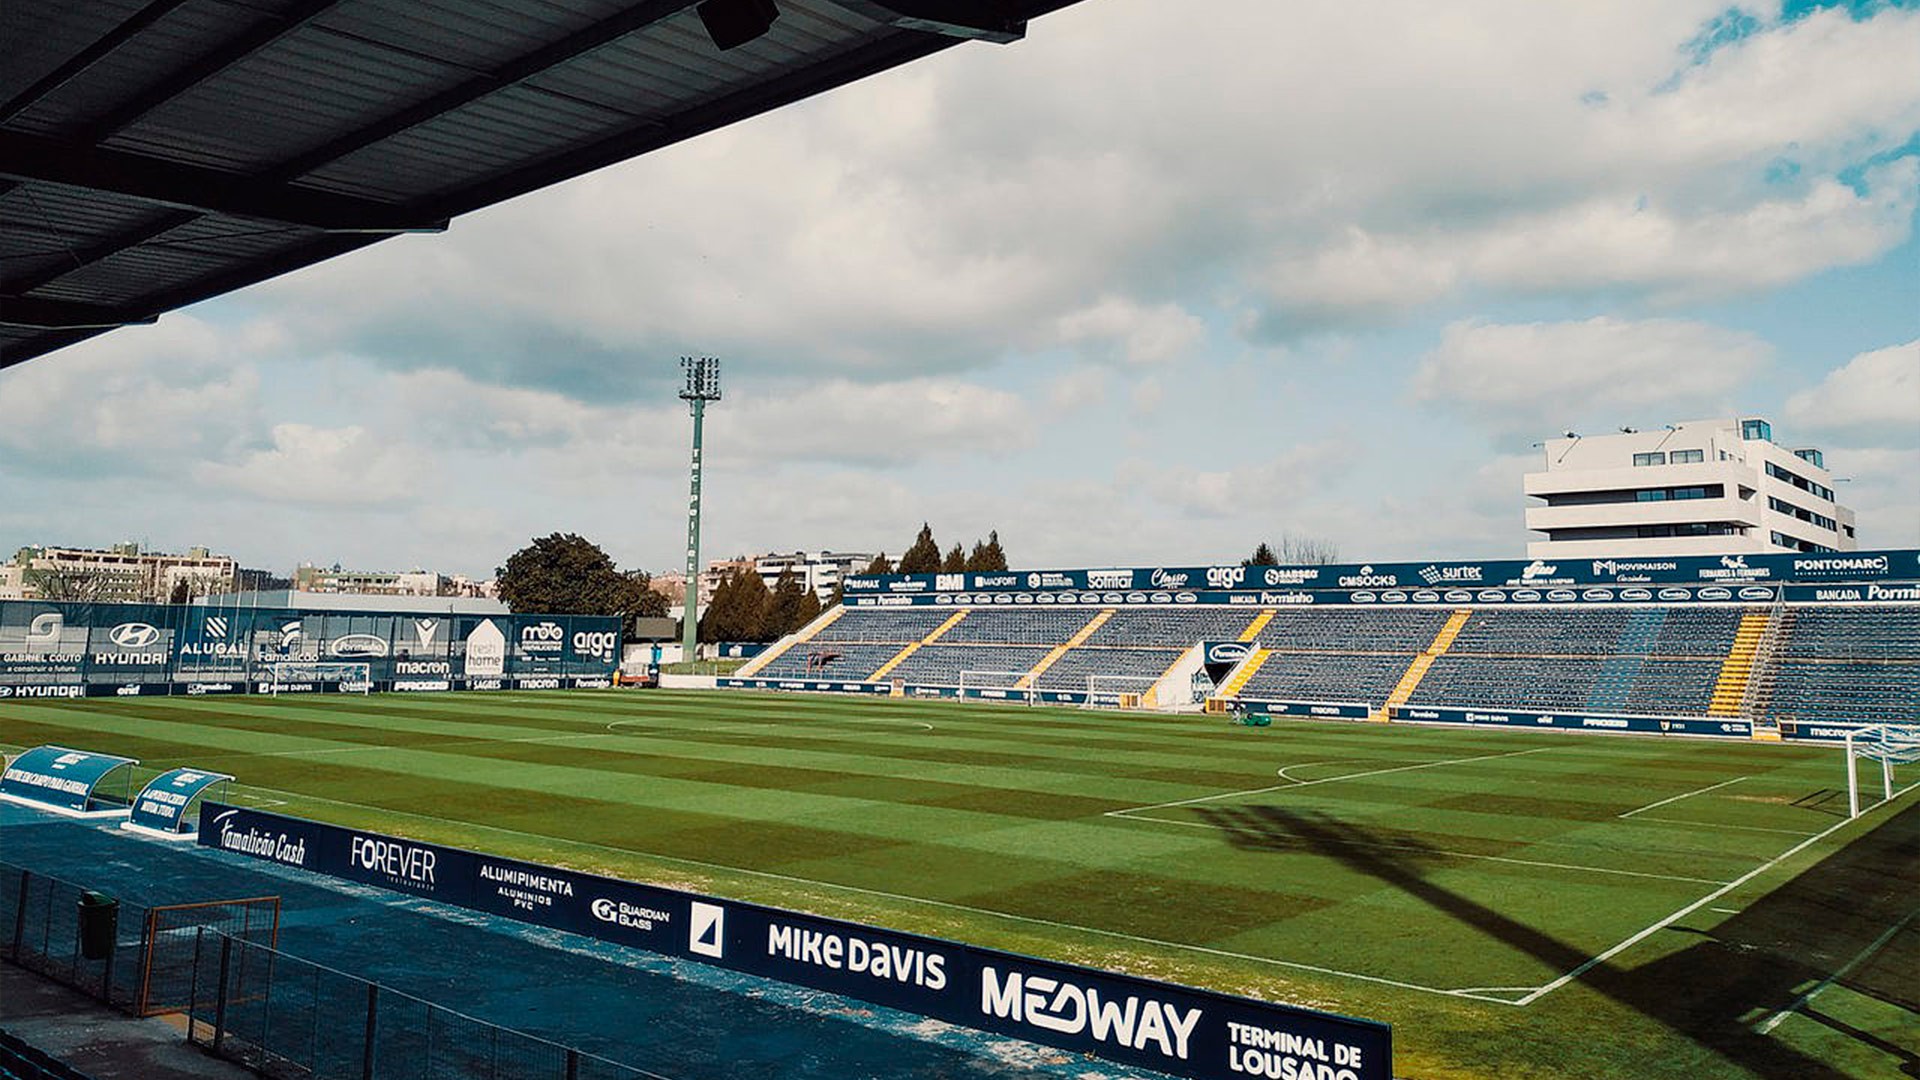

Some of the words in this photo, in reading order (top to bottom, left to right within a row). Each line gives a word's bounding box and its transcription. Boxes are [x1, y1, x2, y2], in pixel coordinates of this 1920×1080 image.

[1794, 558, 1884, 570] PONTOMARC
[1442, 566, 1483, 578] surtec
[1338, 574, 1397, 587] CMSOCKS
[1815, 589, 1861, 600] BANCADA
[180, 642, 249, 655] ALUGAL
[573, 631, 616, 657] arga
[3, 653, 48, 663] GABRIEL
[48, 654, 82, 663] COUTO
[95, 652, 168, 665] HYUNDAI
[468, 655, 502, 667] home
[396, 662, 450, 674] macron
[15, 686, 84, 697] HYUNDAI
[213, 810, 275, 857] Famalicão
[275, 833, 305, 865] Cash
[351, 836, 436, 883] FOREVER
[480, 865, 573, 897] ALUMIPIMENTA
[498, 887, 552, 906] ALUMINIOS
[514, 899, 534, 911] PVC
[619, 902, 670, 923] GUARDIAN
[619, 914, 652, 931] GLASS
[981, 966, 1203, 1060] MEDWAY
[1227, 1021, 1329, 1062] TERMINAL
[1334, 1043, 1362, 1069] DE
